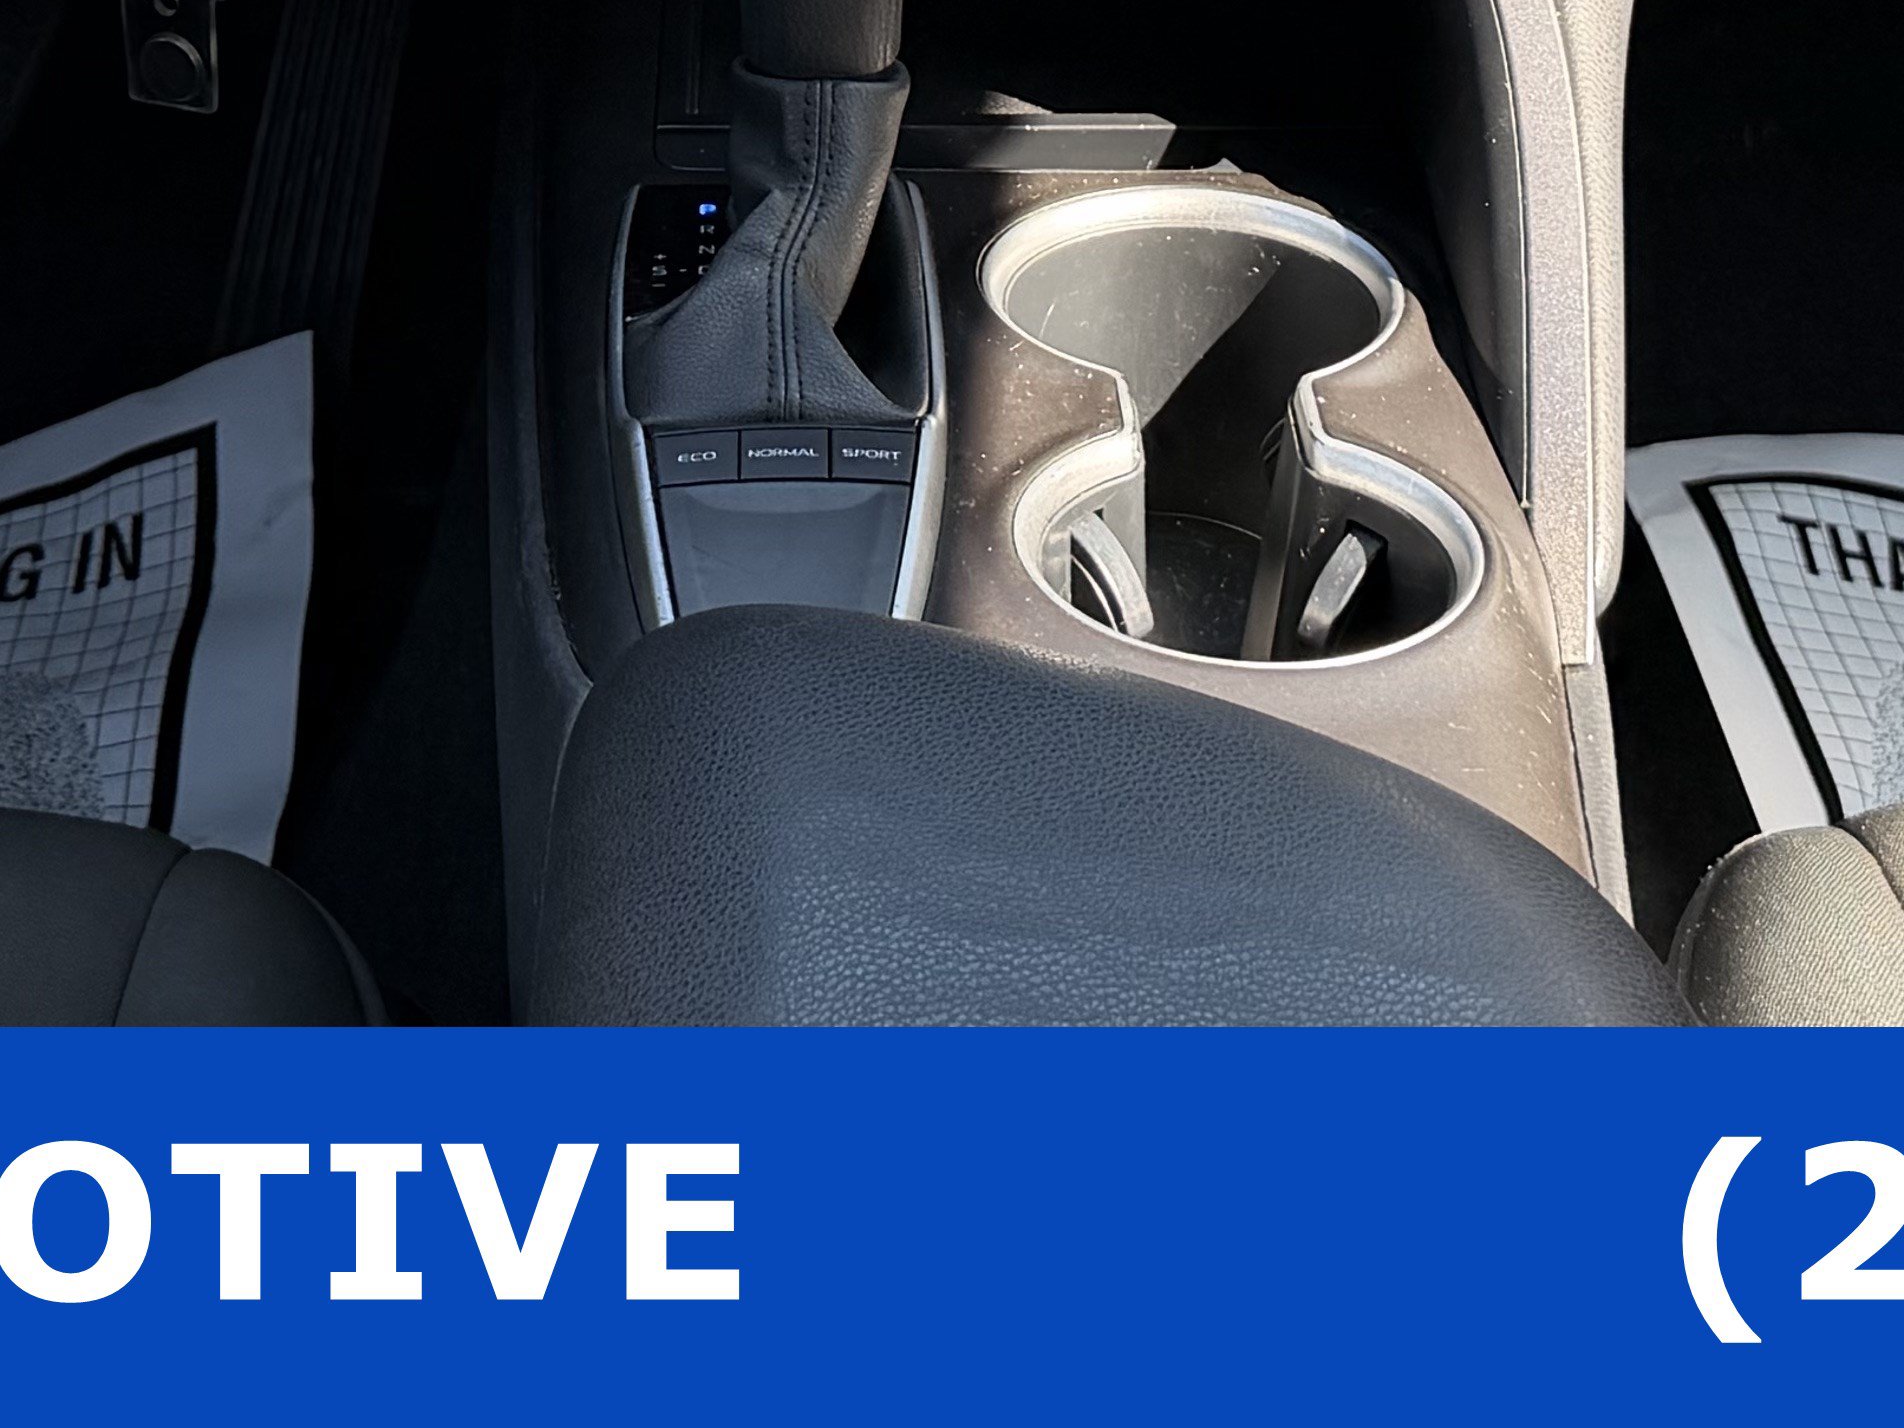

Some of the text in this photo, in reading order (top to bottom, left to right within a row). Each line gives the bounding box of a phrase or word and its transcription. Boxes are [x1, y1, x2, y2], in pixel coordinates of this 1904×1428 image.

[677, 451, 717, 463] ECO
[748, 447, 819, 458] NORMAL
[842, 447, 901, 460] SPORT
[72, 512, 144, 594] IN
